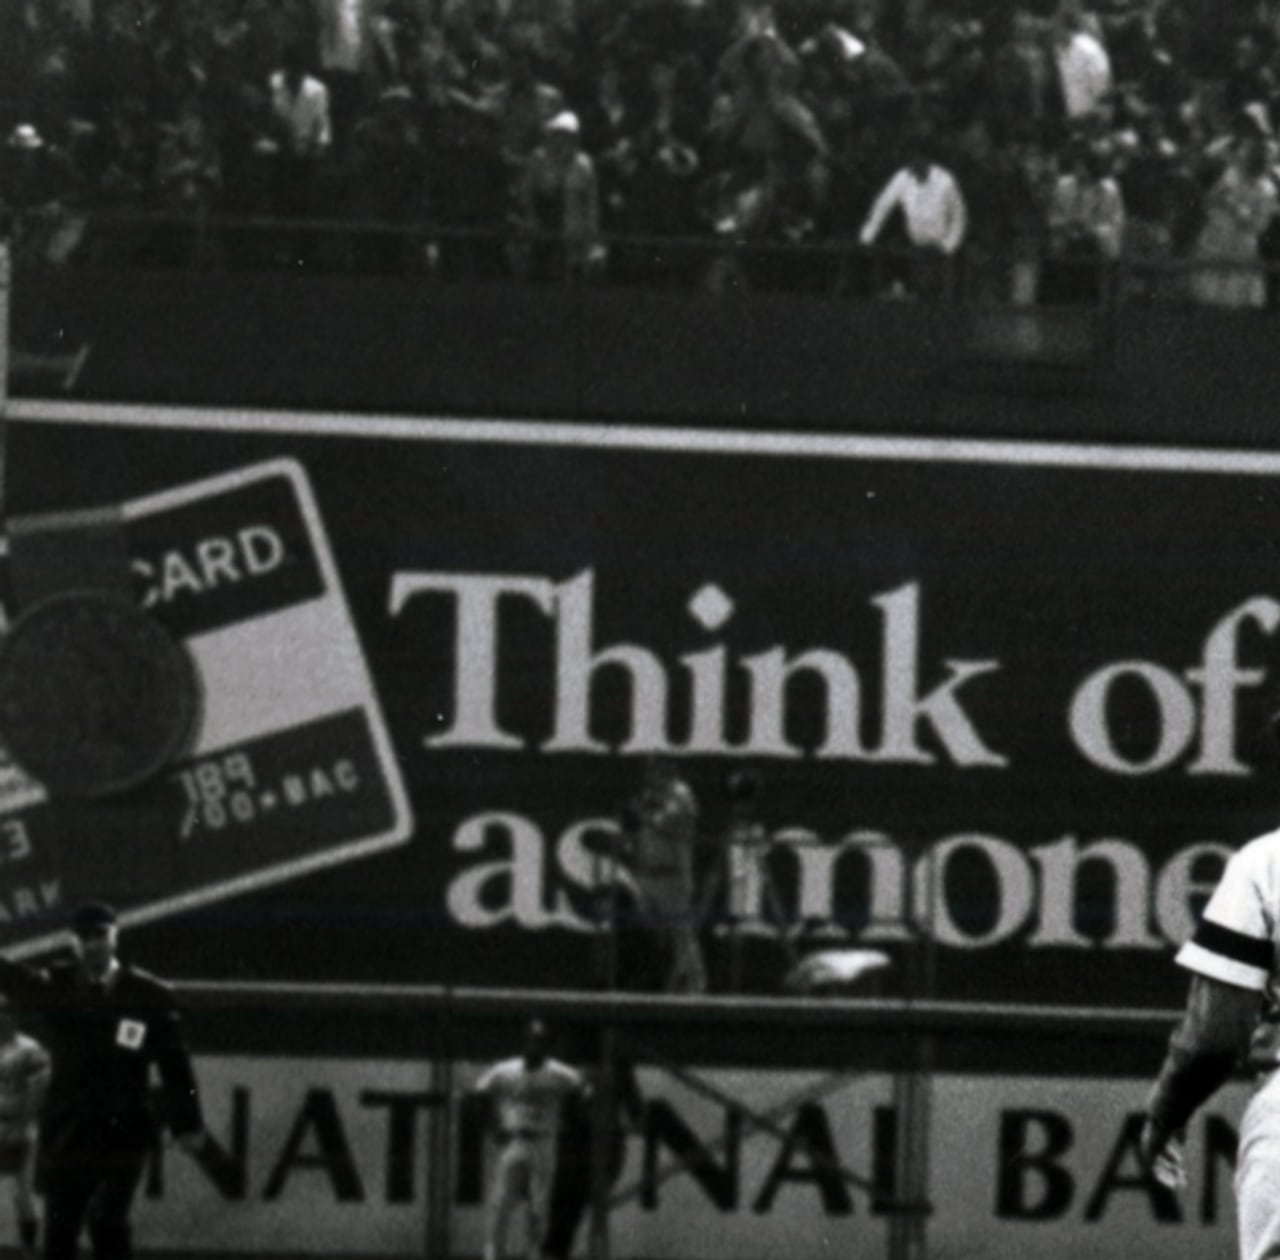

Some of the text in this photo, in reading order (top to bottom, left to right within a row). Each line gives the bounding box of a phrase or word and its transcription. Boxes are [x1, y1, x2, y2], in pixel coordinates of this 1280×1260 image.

[388, 567, 1008, 768] Think
[447, 811, 642, 933] as
[146, 1085, 932, 1217] NATINAL
